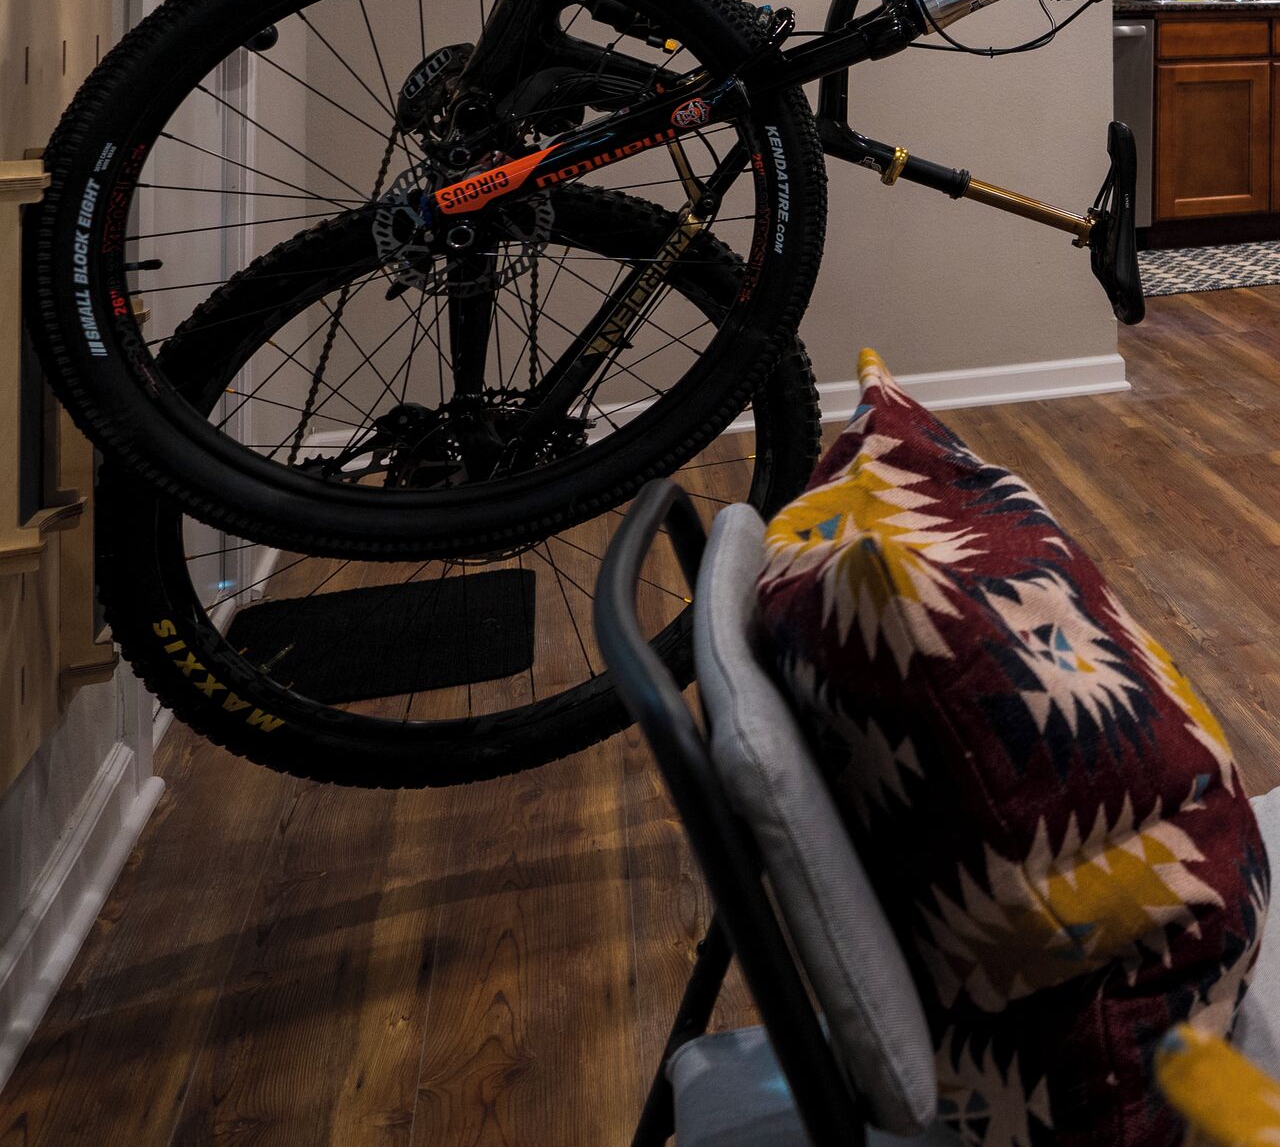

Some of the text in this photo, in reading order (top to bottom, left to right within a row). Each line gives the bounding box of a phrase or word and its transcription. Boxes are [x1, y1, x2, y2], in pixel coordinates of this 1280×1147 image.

[440, 169, 510, 210] CIRCUS
[764, 125, 791, 254] KENDATIRE.COM
[73, 177, 101, 340] SMALL BLOCK EIGHT
[151, 618, 287, 733] MAXXIS
